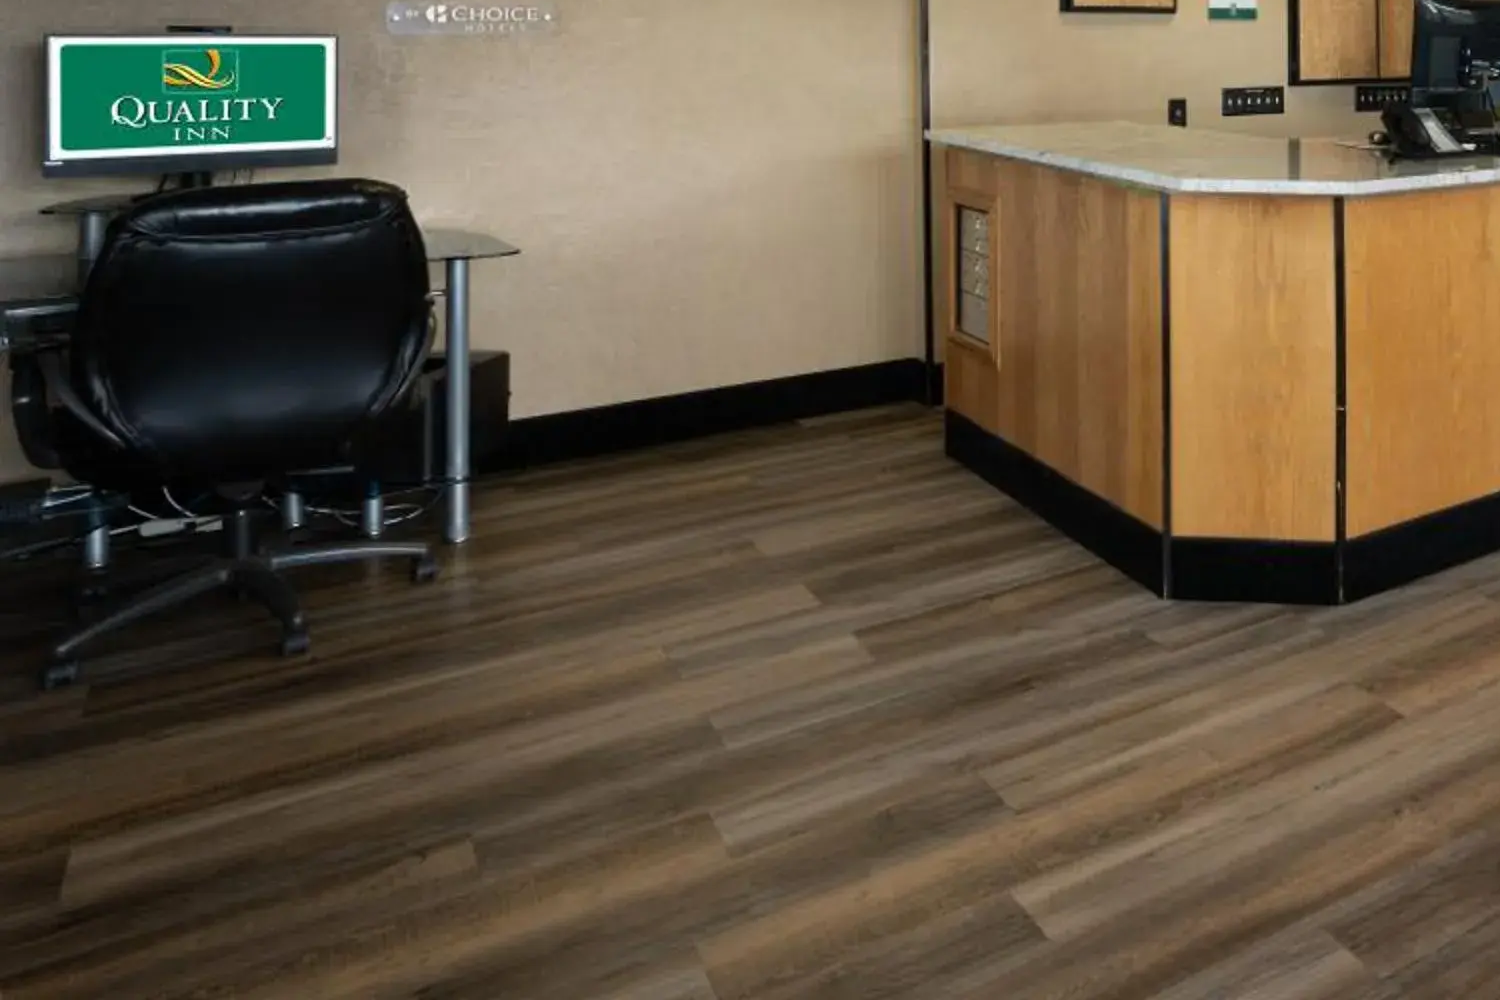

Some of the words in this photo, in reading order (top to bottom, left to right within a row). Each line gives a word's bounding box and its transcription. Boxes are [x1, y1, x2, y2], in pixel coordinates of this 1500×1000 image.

[451, 6, 540, 22] CHOICE
[111, 95, 283, 129] QUALITY
[174, 126, 231, 141] INN
